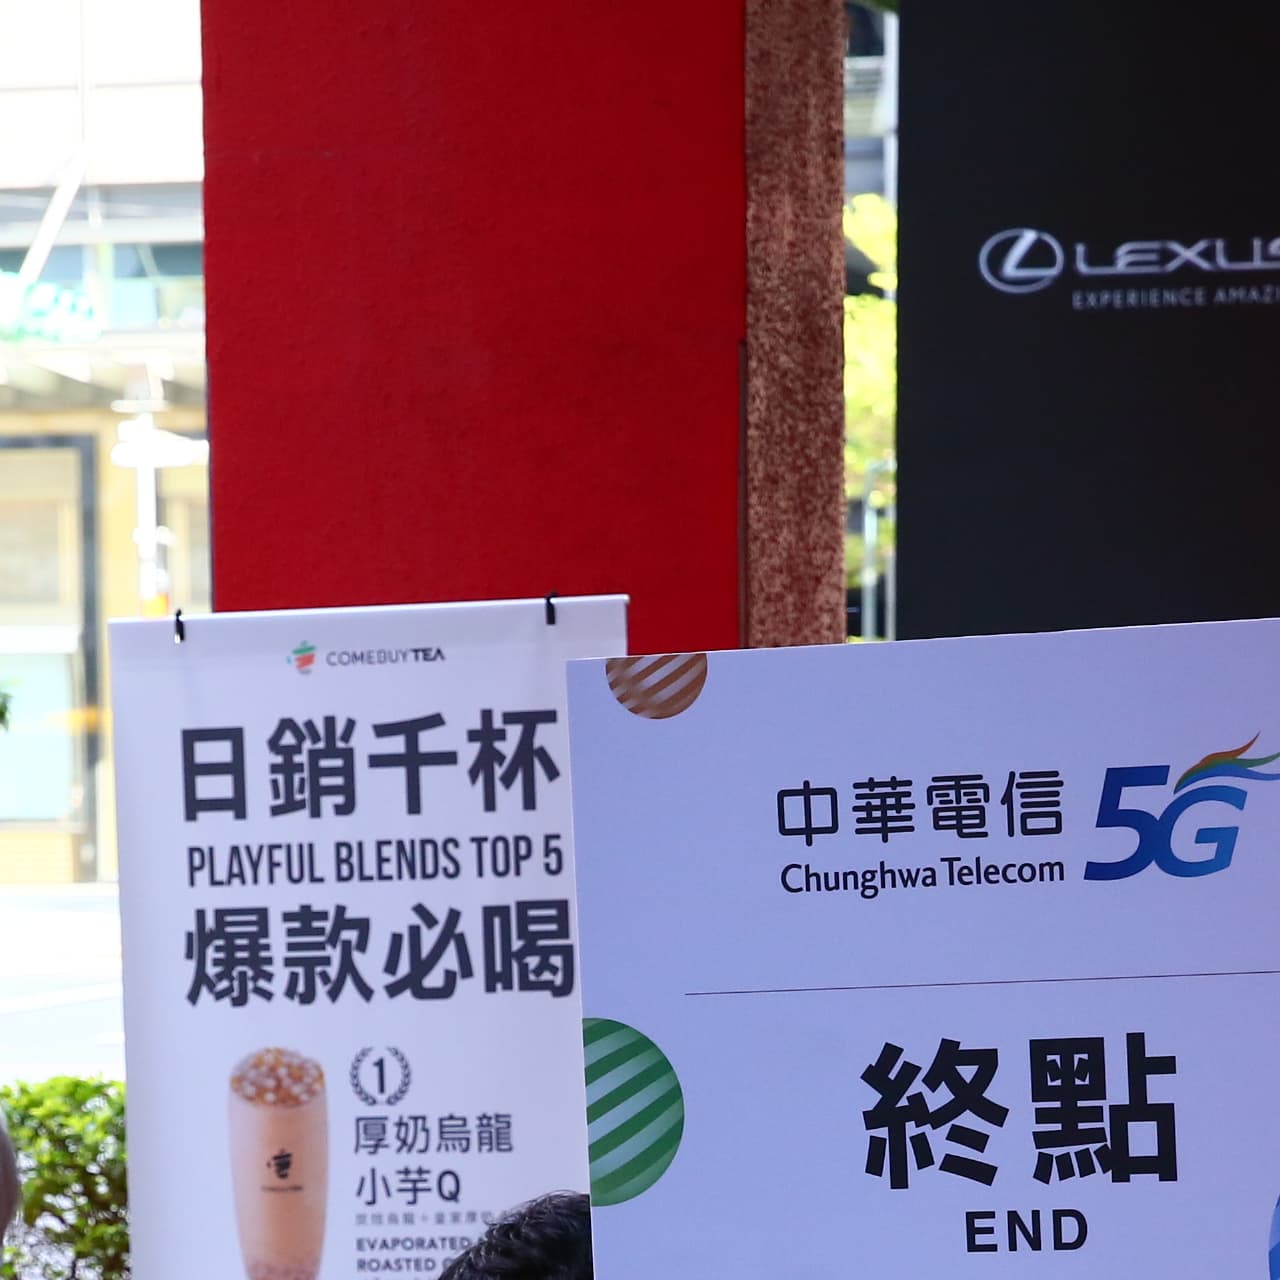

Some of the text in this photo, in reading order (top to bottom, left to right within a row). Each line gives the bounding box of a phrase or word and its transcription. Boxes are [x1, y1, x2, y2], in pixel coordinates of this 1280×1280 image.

[1072, 287, 1206, 310] EXPERIENCE
[180, 708, 561, 822] 日銷千杯
[776, 769, 1065, 848] 中華電信
[1083, 763, 1249, 882] 5G
[187, 834, 564, 888] PLAYFUL BLENDS TOP 5
[780, 855, 1066, 900] Chunghwa Telecom
[184, 898, 576, 1007] 爆款必喝
[372, 1057, 388, 1095] 1
[860, 1031, 1179, 1190] 終點
[353, 1112, 514, 1156] 厚奶烏龍
[355, 1167, 462, 1206] 小芋Q
[356, 1236, 470, 1252] EVAPORATED
[964, 1208, 1090, 1254] END
[357, 1257, 436, 1273] ROASTED
